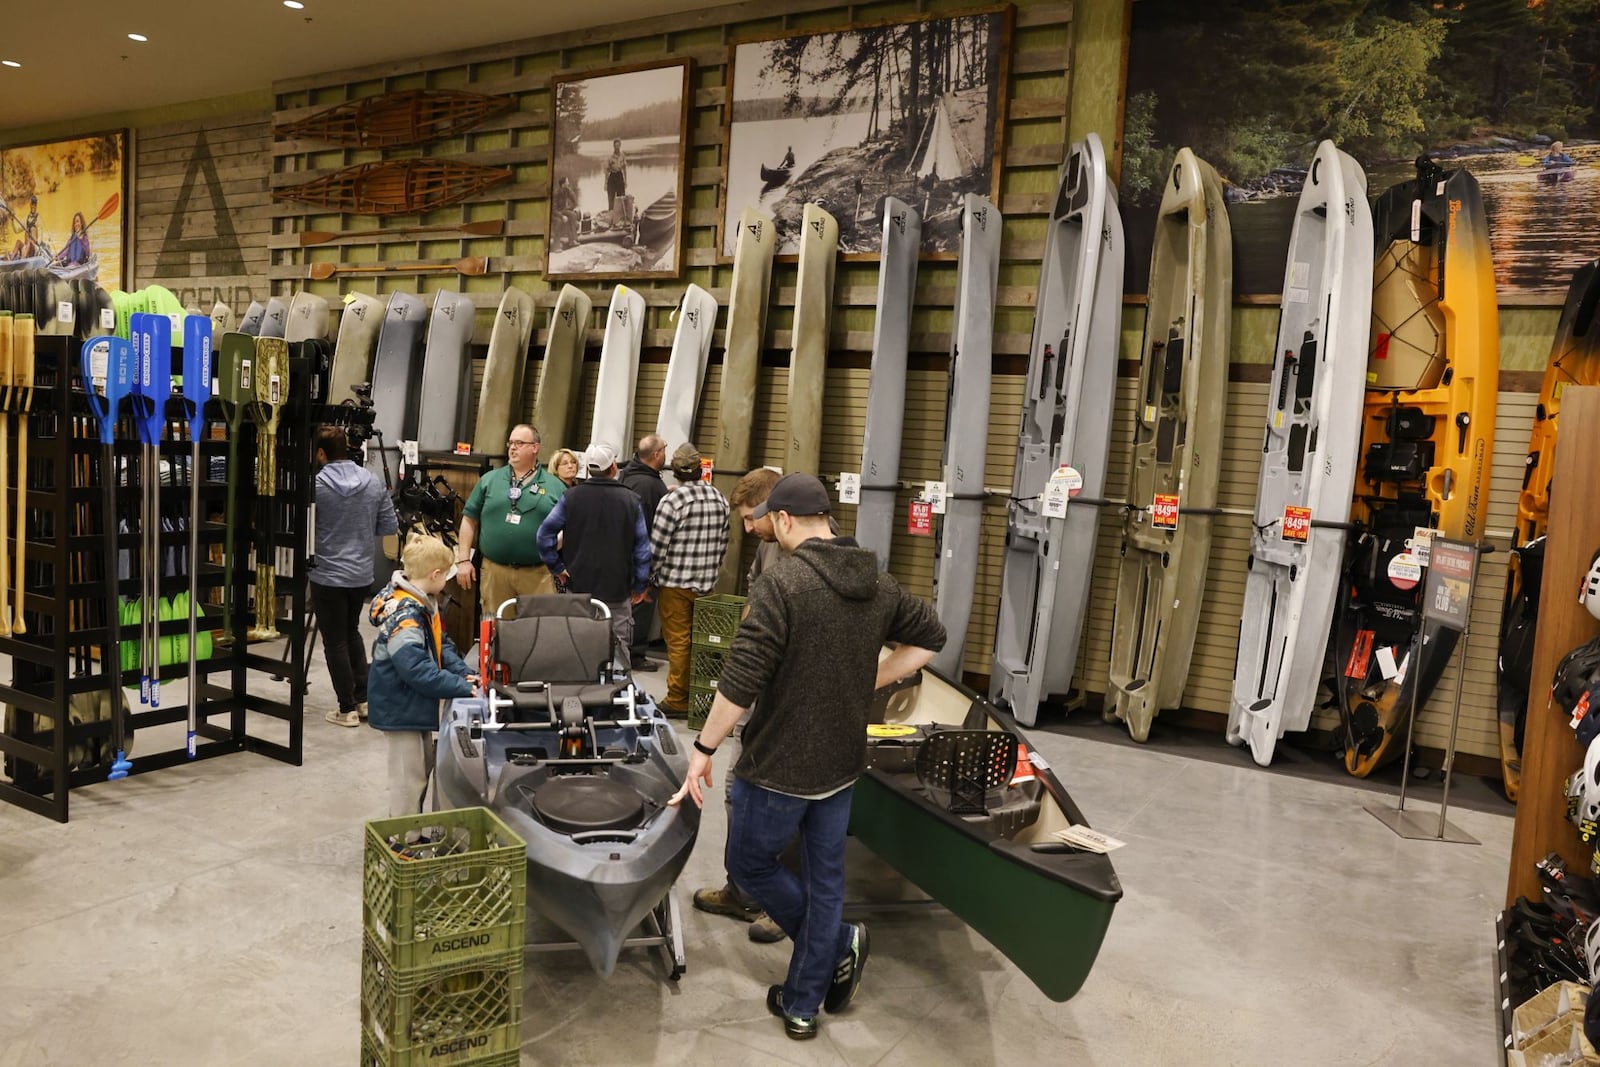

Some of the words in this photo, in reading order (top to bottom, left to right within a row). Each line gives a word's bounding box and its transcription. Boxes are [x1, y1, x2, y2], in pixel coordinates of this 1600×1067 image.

[1467, 486, 1480, 513] Town
[1465, 513, 1476, 536] Old
[1435, 594, 1449, 612] CLUB
[432, 933, 490, 954] ASCEND
[430, 1034, 488, 1058] ASCEND
